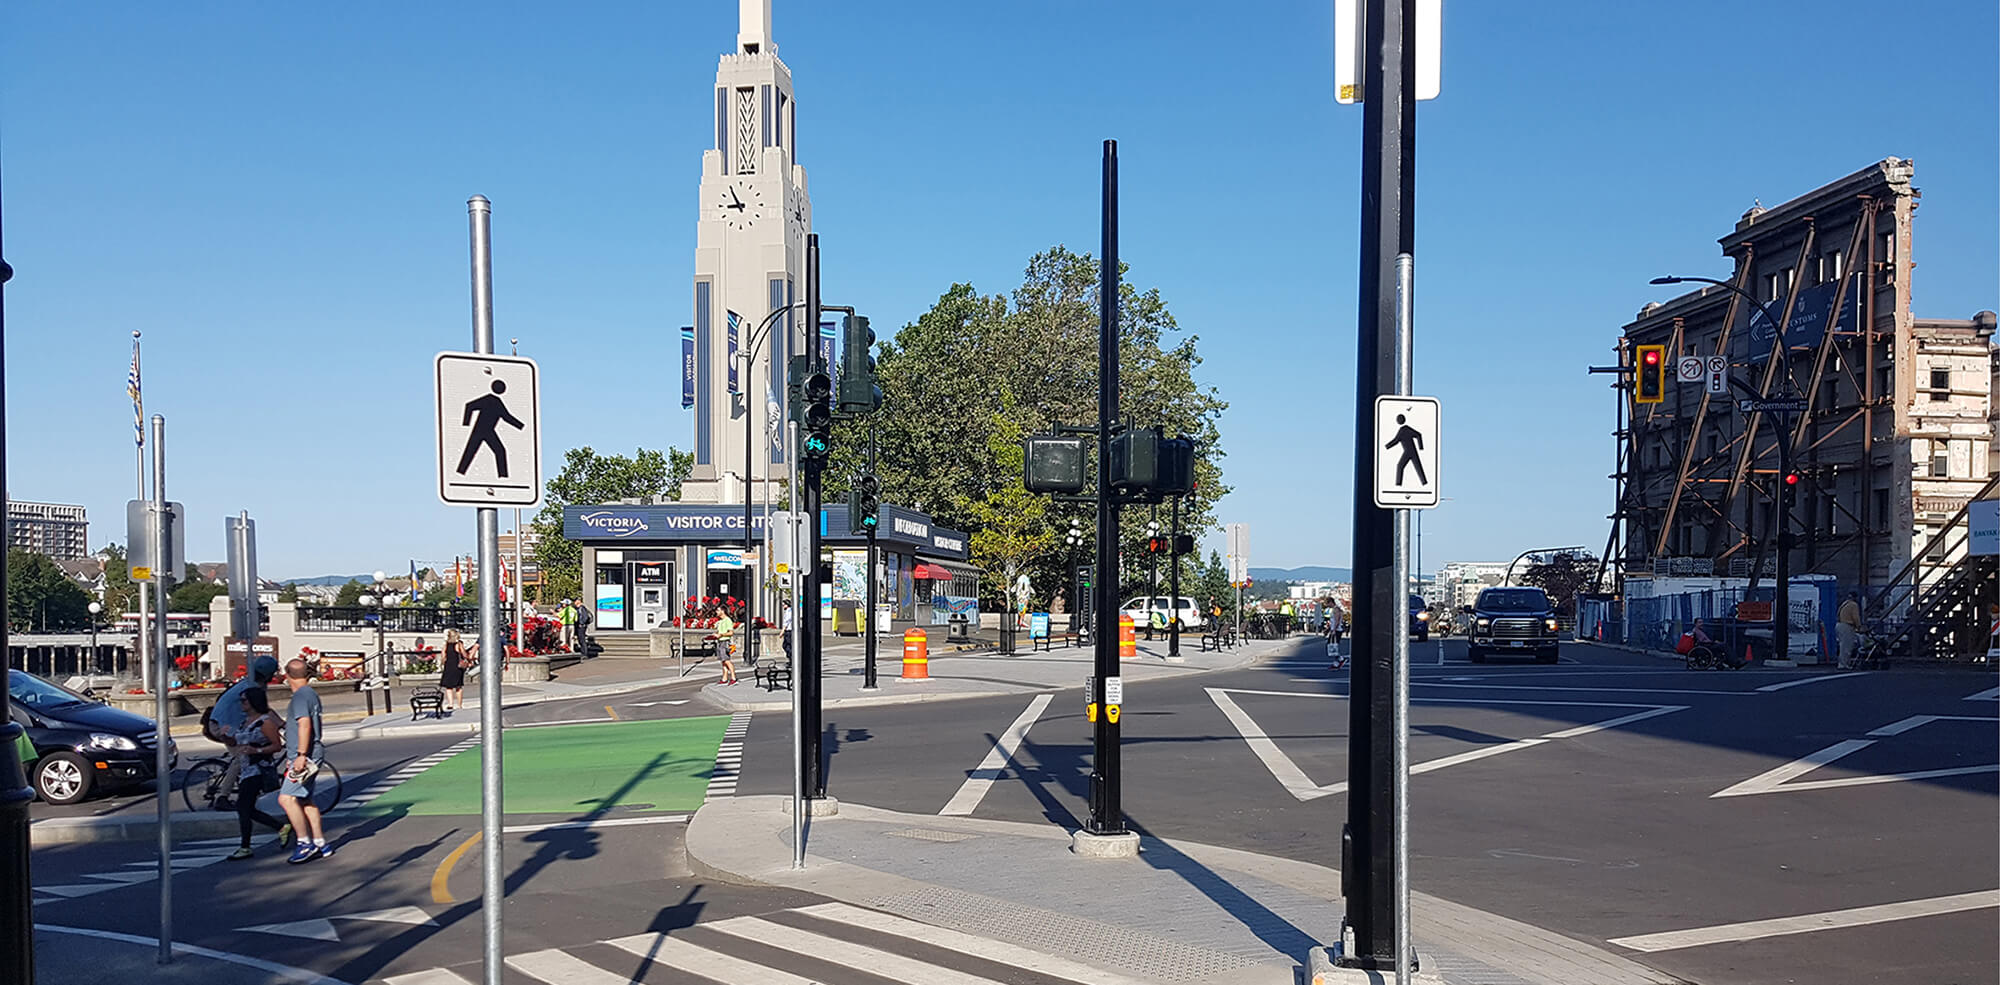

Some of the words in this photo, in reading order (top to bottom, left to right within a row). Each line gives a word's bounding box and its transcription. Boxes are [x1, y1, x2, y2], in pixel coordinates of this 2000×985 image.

[1752, 401, 1798, 410] Government
[585, 517, 643, 527] VICTORIA
[667, 516, 720, 529] VISITOR
[726, 516, 774, 529] CENTR
[641, 567, 660, 576] ATM
